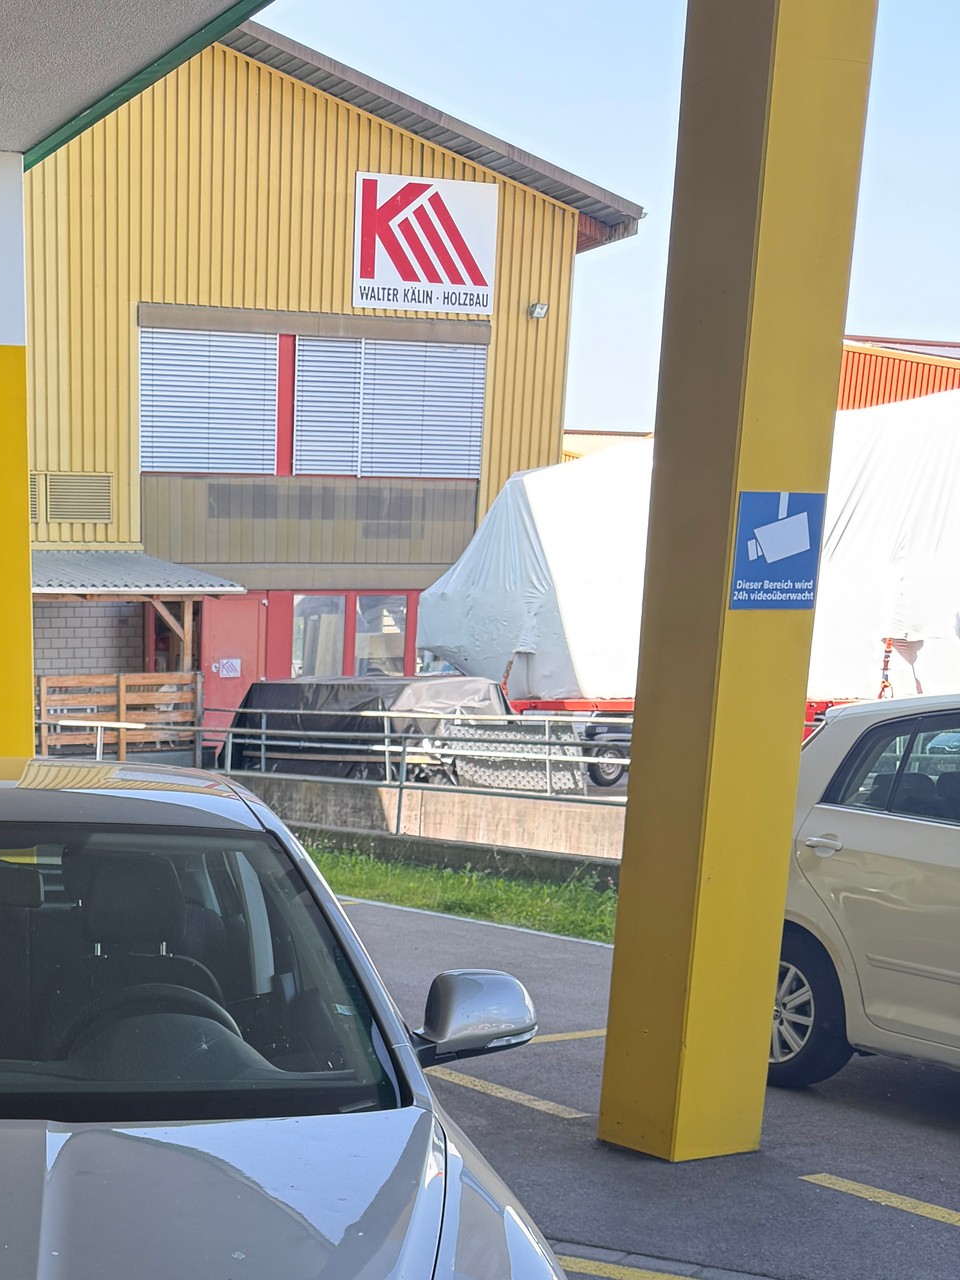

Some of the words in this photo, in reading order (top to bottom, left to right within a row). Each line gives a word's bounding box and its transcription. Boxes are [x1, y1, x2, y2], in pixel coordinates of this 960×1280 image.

[359, 285, 399, 303] WALTER
[403, 287, 433, 305] KÄLIN
[442, 291, 489, 308] HOLZBAU
[736, 580, 762, 589] Dieser
[763, 580, 793, 589] Bereich
[794, 580, 814, 590] wird
[732, 591, 748, 600] 24h
[749, 591, 814, 600] videoüberwacht
